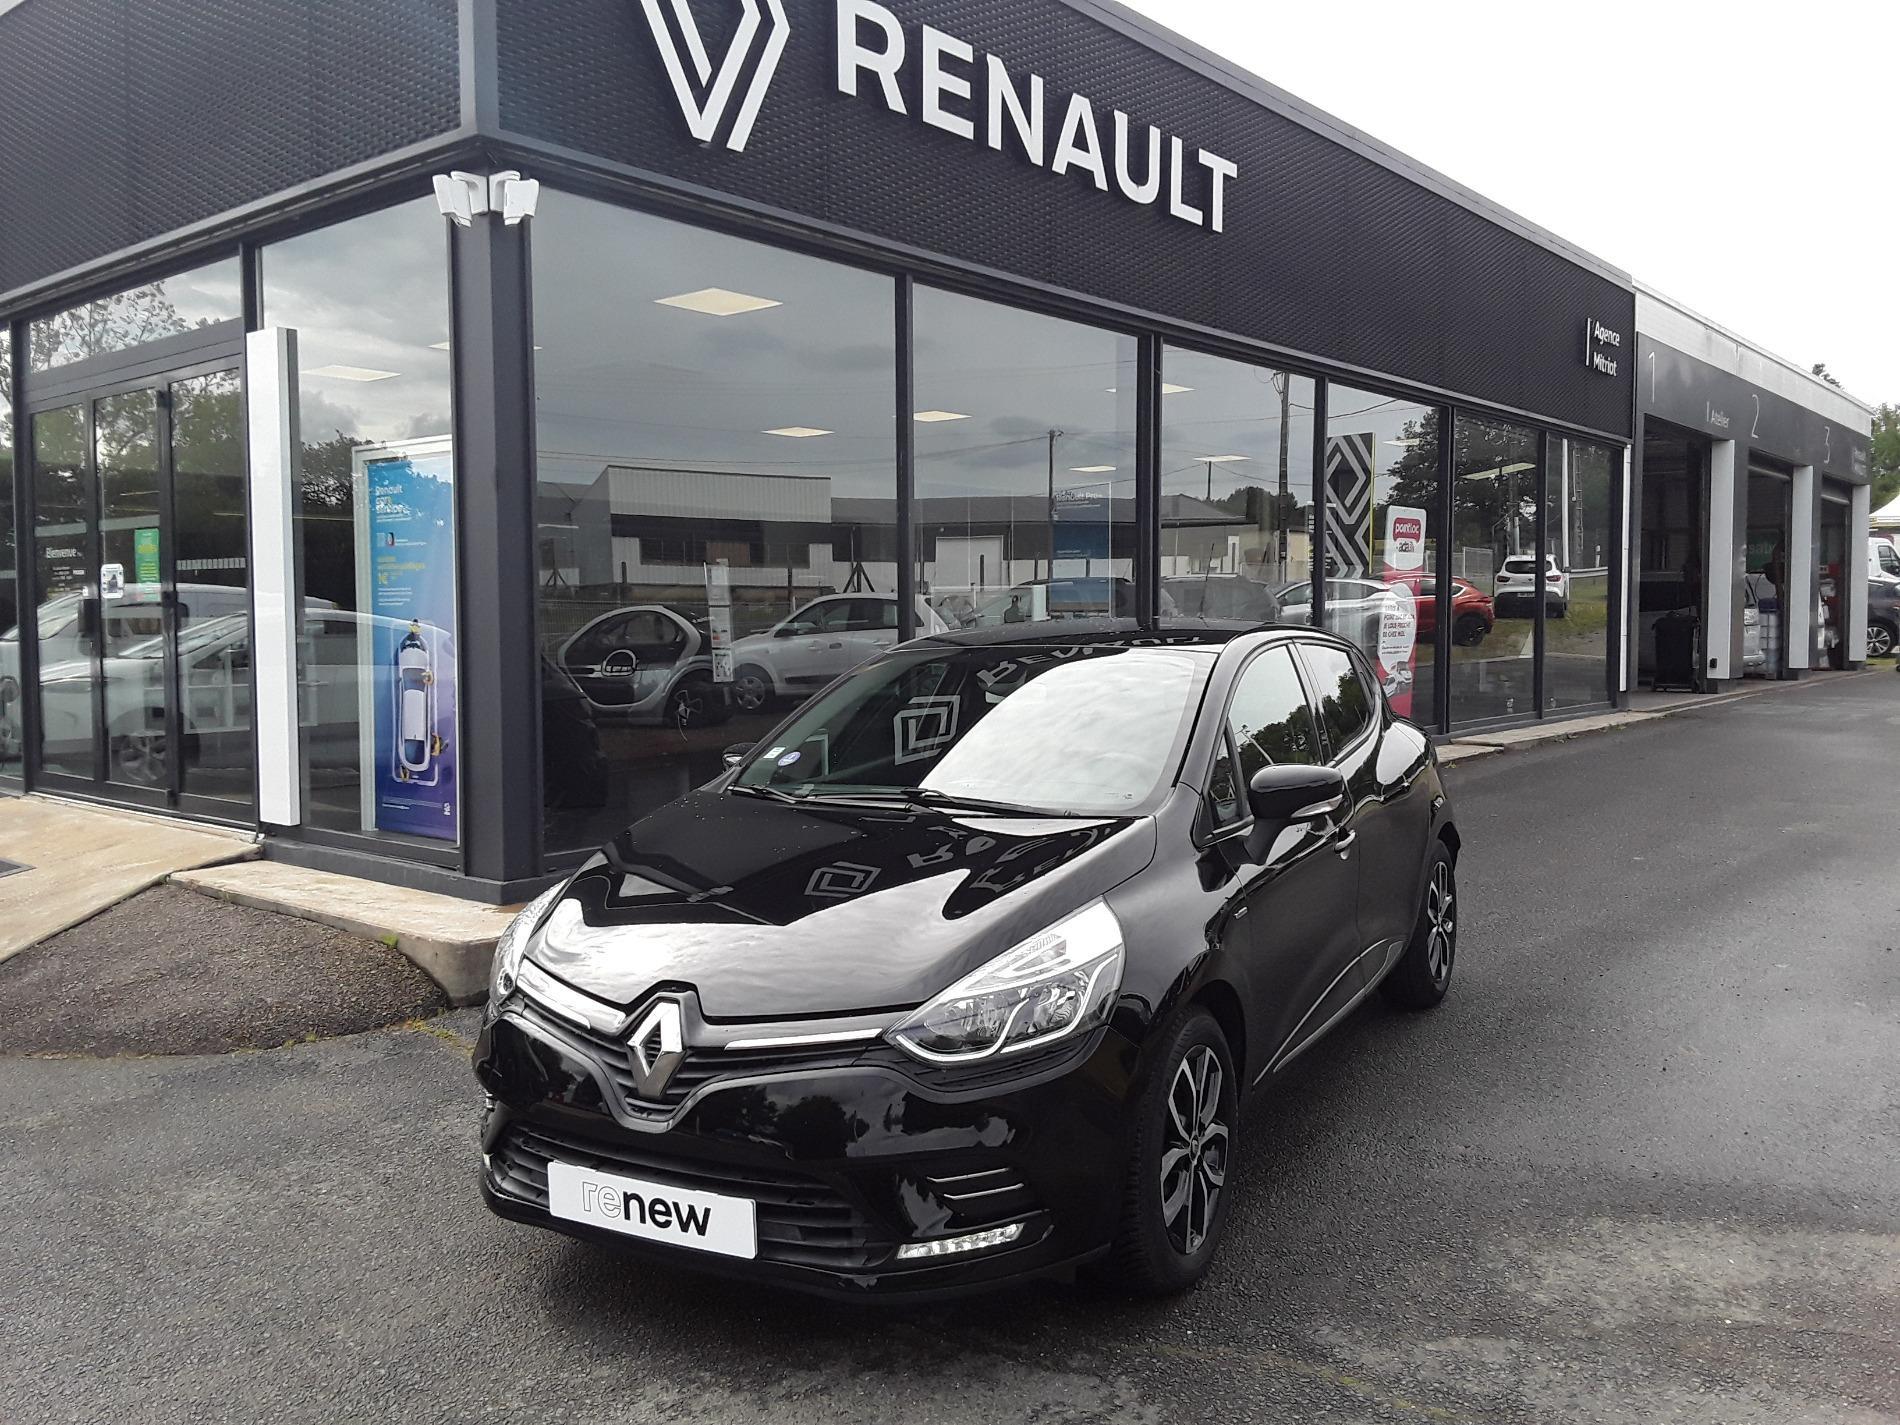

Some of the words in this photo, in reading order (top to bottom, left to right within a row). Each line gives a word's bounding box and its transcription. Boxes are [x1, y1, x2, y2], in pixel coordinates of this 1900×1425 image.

[837, 0, 1237, 233] RENAULT
[1594, 321, 1620, 347] Agence
[1593, 352, 1617, 376] Mitriot
[1648, 351, 1655, 404] 1
[1752, 394, 1760, 438] 2
[1824, 426, 1830, 464] 3
[582, 1181, 711, 1236] renew
